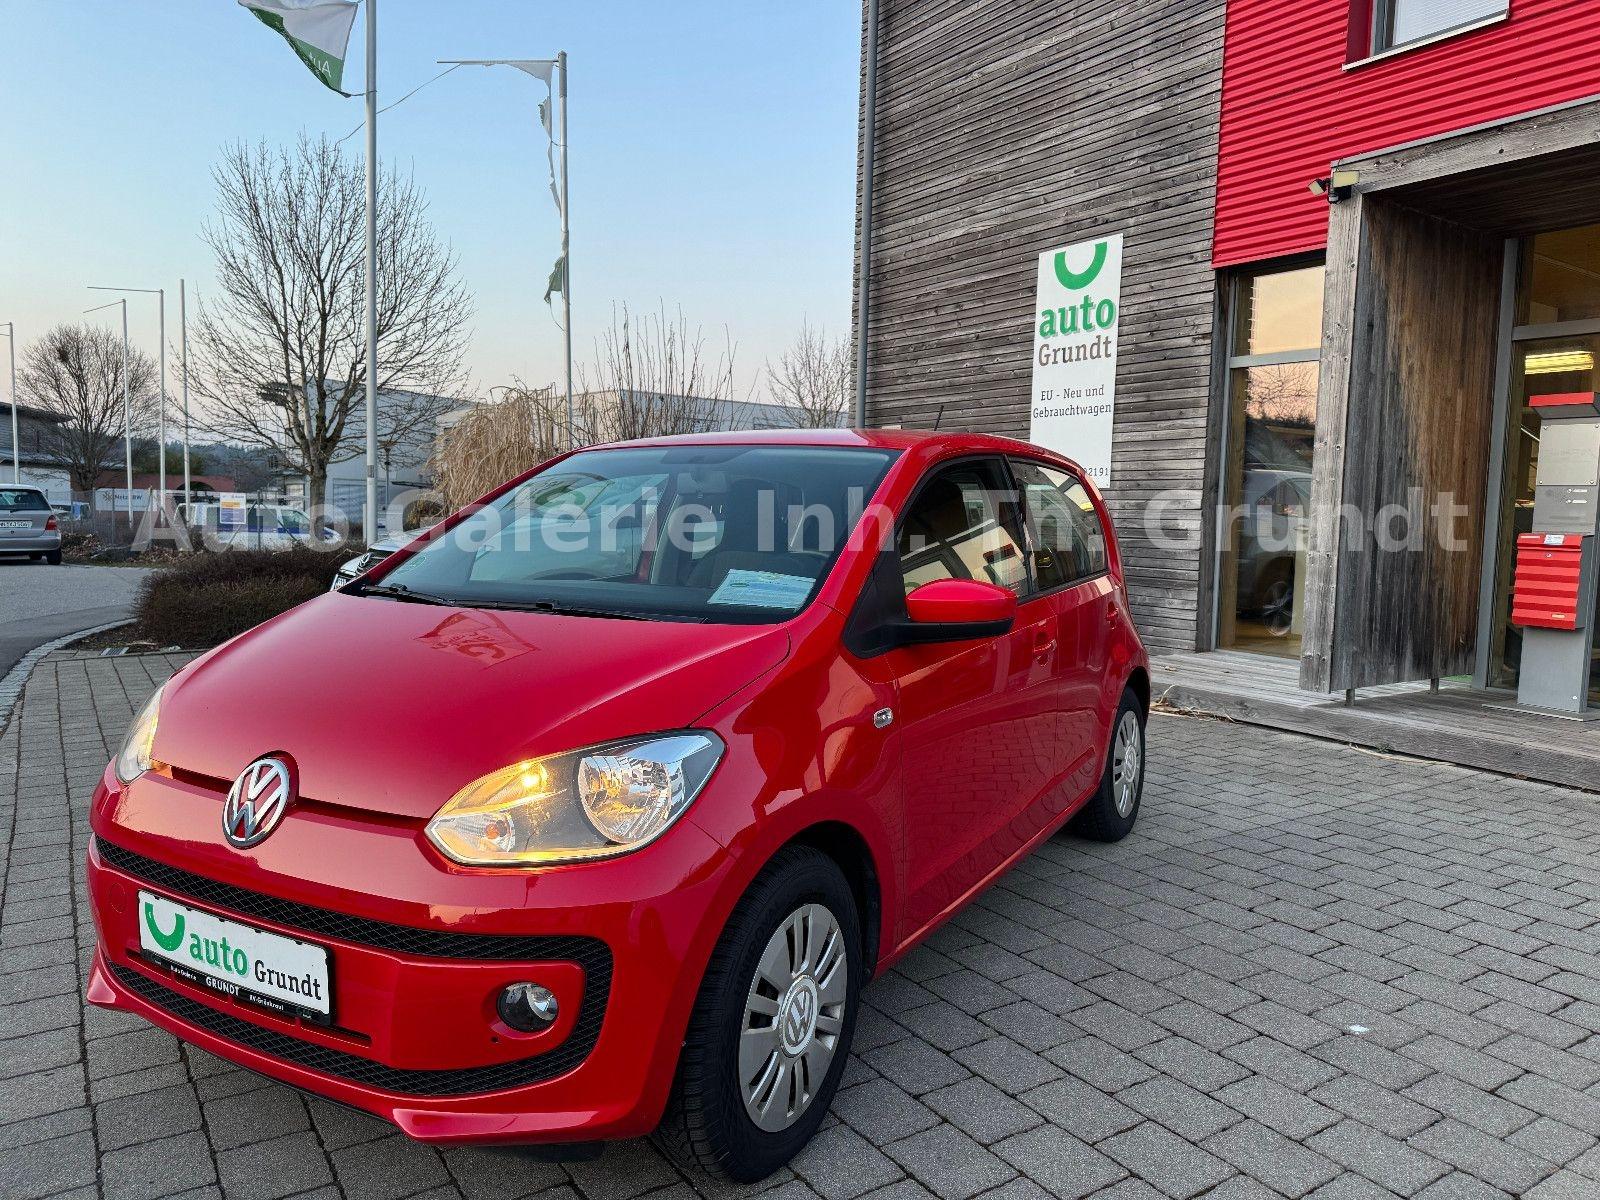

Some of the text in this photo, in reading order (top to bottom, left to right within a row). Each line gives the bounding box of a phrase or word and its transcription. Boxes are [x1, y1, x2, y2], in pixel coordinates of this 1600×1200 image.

[1039, 295, 1117, 340] auto
[1038, 334, 1112, 367] Grundt
[1033, 402, 1112, 419] Gebrauchtwagen
[1041, 389, 1054, 401] EU
[1063, 387, 1082, 400] Neu
[1085, 384, 1105, 398] und
[224, 758, 290, 843] VW
[189, 933, 322, 1000] auto Grundt
[205, 975, 240, 997] GRUNDT
[783, 984, 815, 1047] VW
